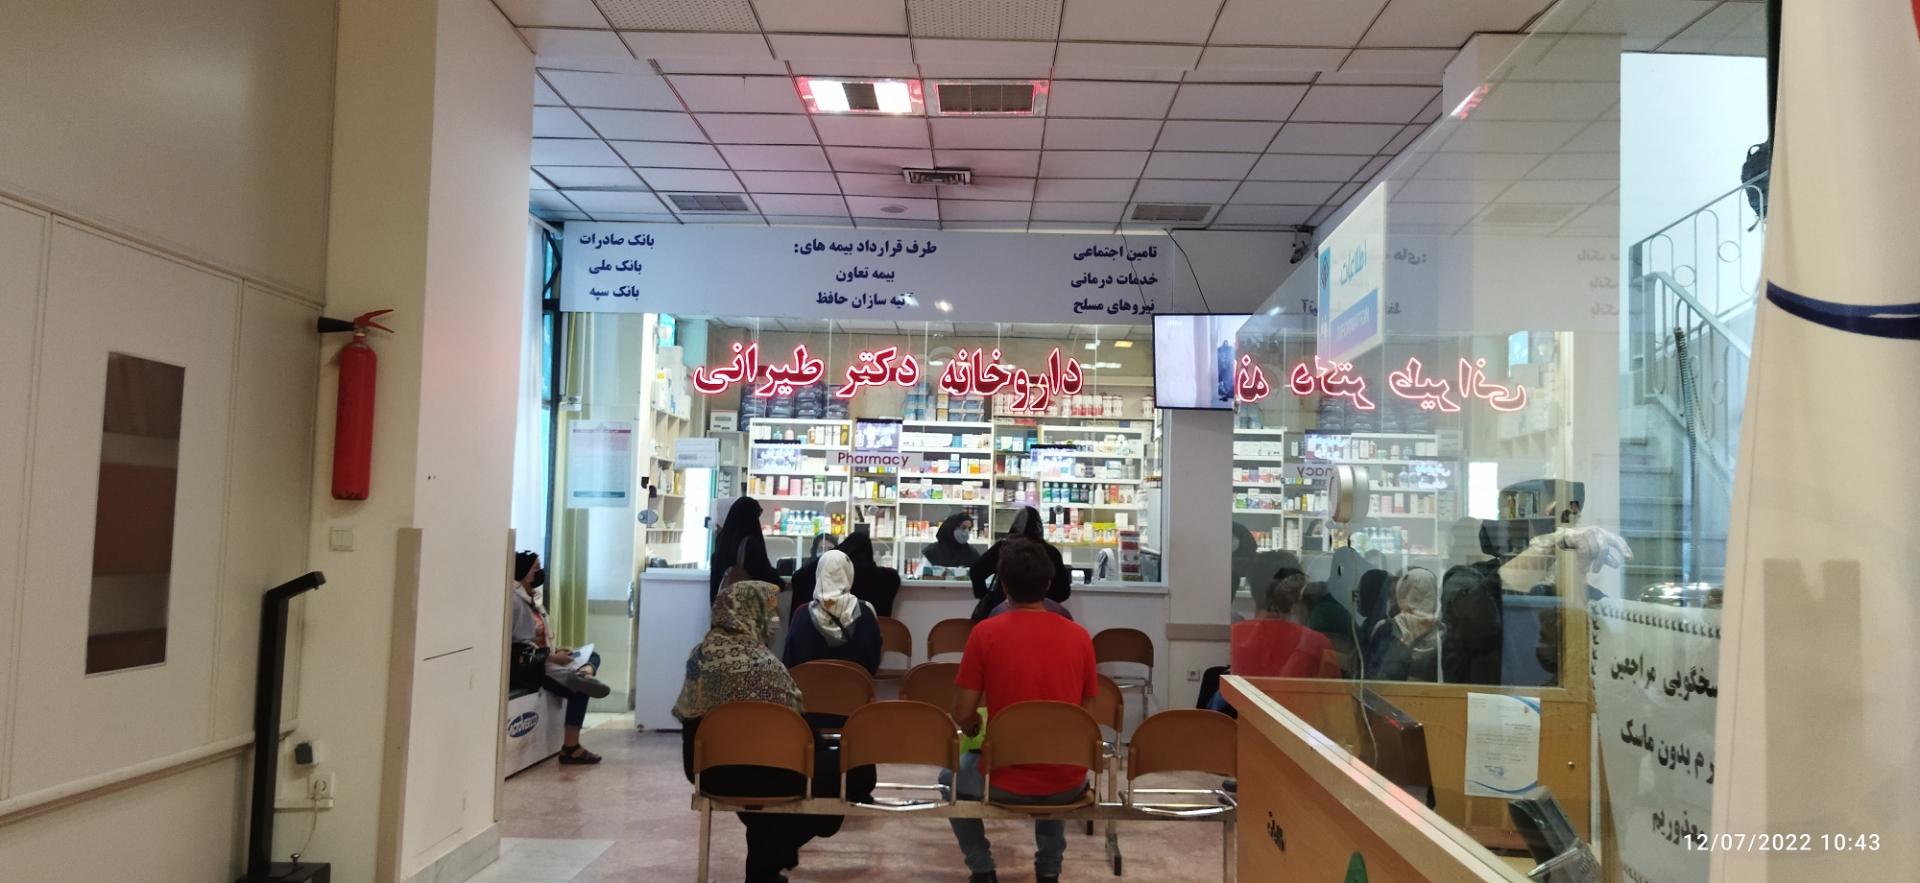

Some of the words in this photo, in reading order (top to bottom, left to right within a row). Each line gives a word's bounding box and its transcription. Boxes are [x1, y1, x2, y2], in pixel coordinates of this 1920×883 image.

[579, 233, 624, 249] صادرات
[627, 233, 655, 248] بانک
[793, 238, 826, 256] های:
[829, 241, 854, 255] بیمه
[856, 239, 903, 256] قرارداد
[905, 240, 937, 257] طرف
[1073, 245, 1124, 261] اجتماعی
[1126, 244, 1158, 261] تامین
[588, 259, 613, 274] ملی
[614, 260, 642, 275] بانک
[836, 266, 868, 283] تعاون
[871, 269, 896, 283] بیمه
[1070, 272, 1114, 289] درمانی
[1116, 271, 1158, 286] خدمات
[588, 288, 610, 302] سپه
[613, 285, 640, 301] بانک
[815, 291, 848, 305] حافظ
[851, 292, 887, 309] سازان
[889, 291, 914, 309] تیه
[1073, 298, 1104, 314] مسلح
[1107, 298, 1156, 315] نیروهای
[693, 342, 825, 397] طیرانی
[836, 346, 921, 398] دکتر
[940, 346, 1084, 412] داروخانه
[837, 452, 910, 466] Pharmacy
[1663, 664, 1719, 702] سخگویی
[1620, 719, 1655, 752] ماسک
[1658, 740, 1691, 774] بدون
